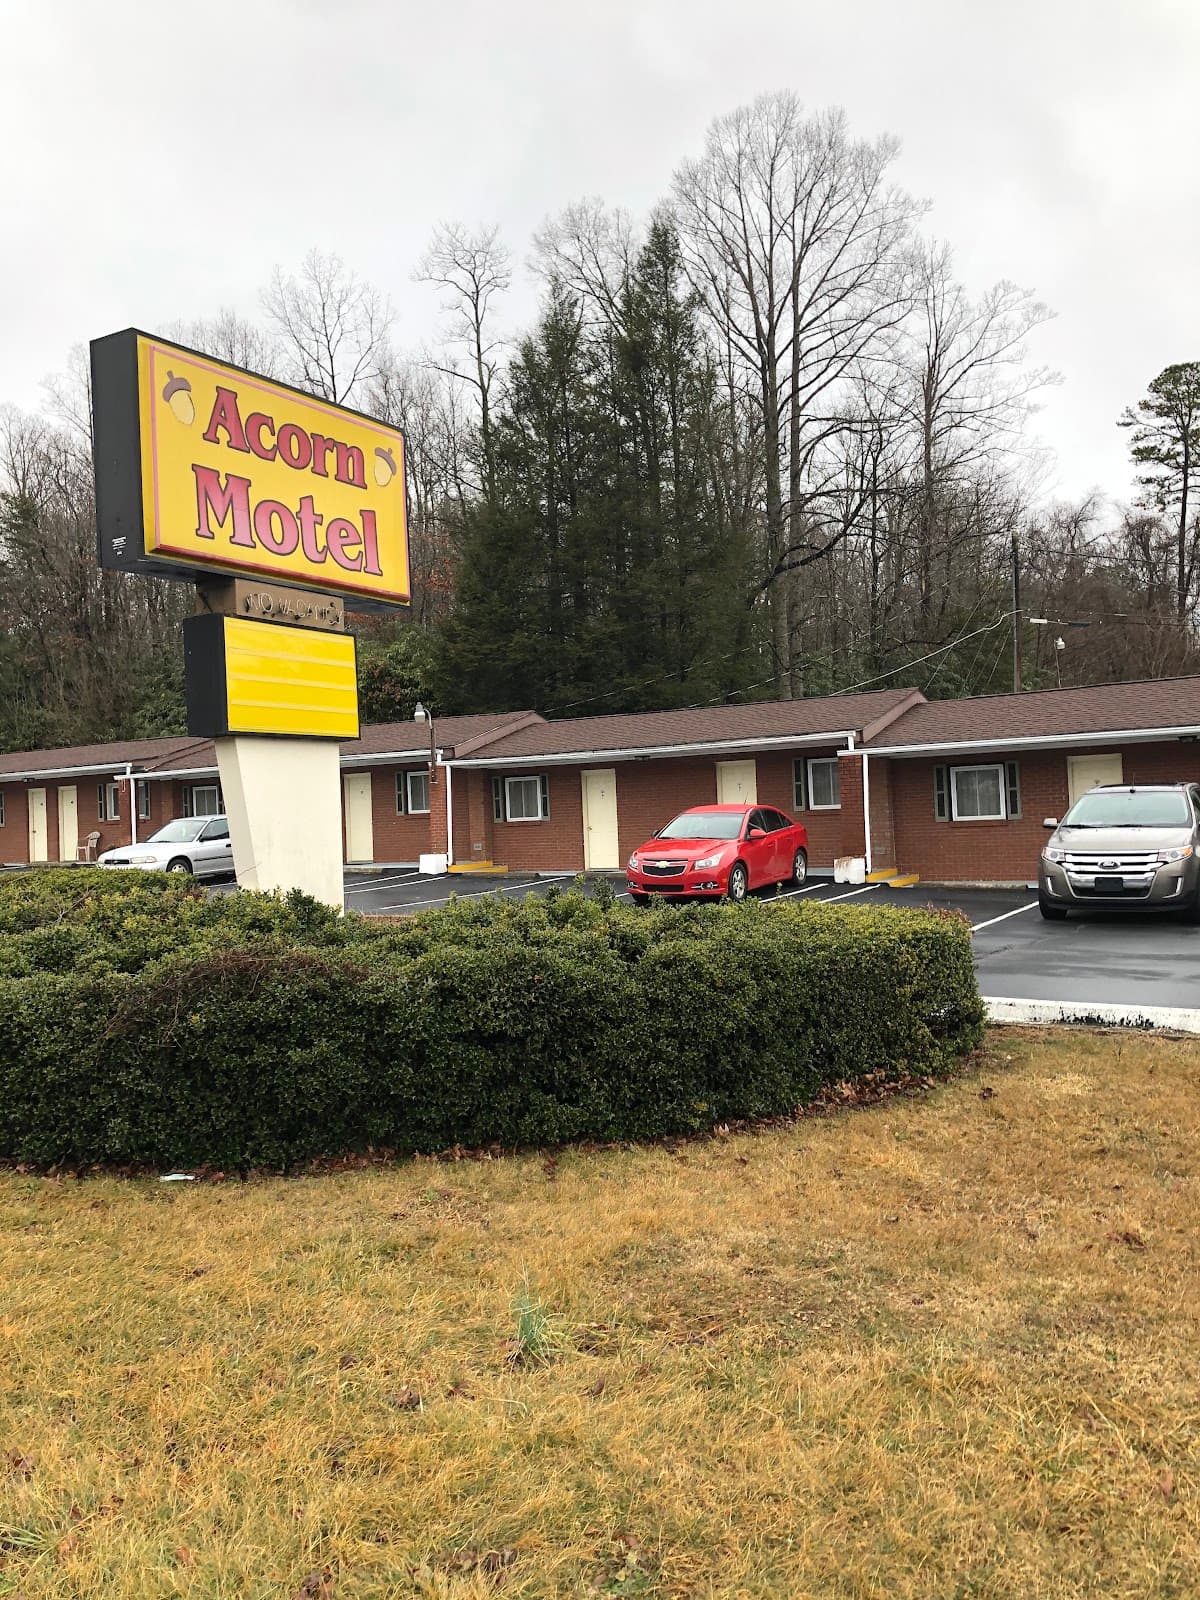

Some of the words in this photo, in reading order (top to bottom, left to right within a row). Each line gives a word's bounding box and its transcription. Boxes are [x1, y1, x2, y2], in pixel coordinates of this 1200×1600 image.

[203, 386, 367, 489] Acorn
[192, 464, 383, 576] Motel
[246, 593, 274, 613] NO
